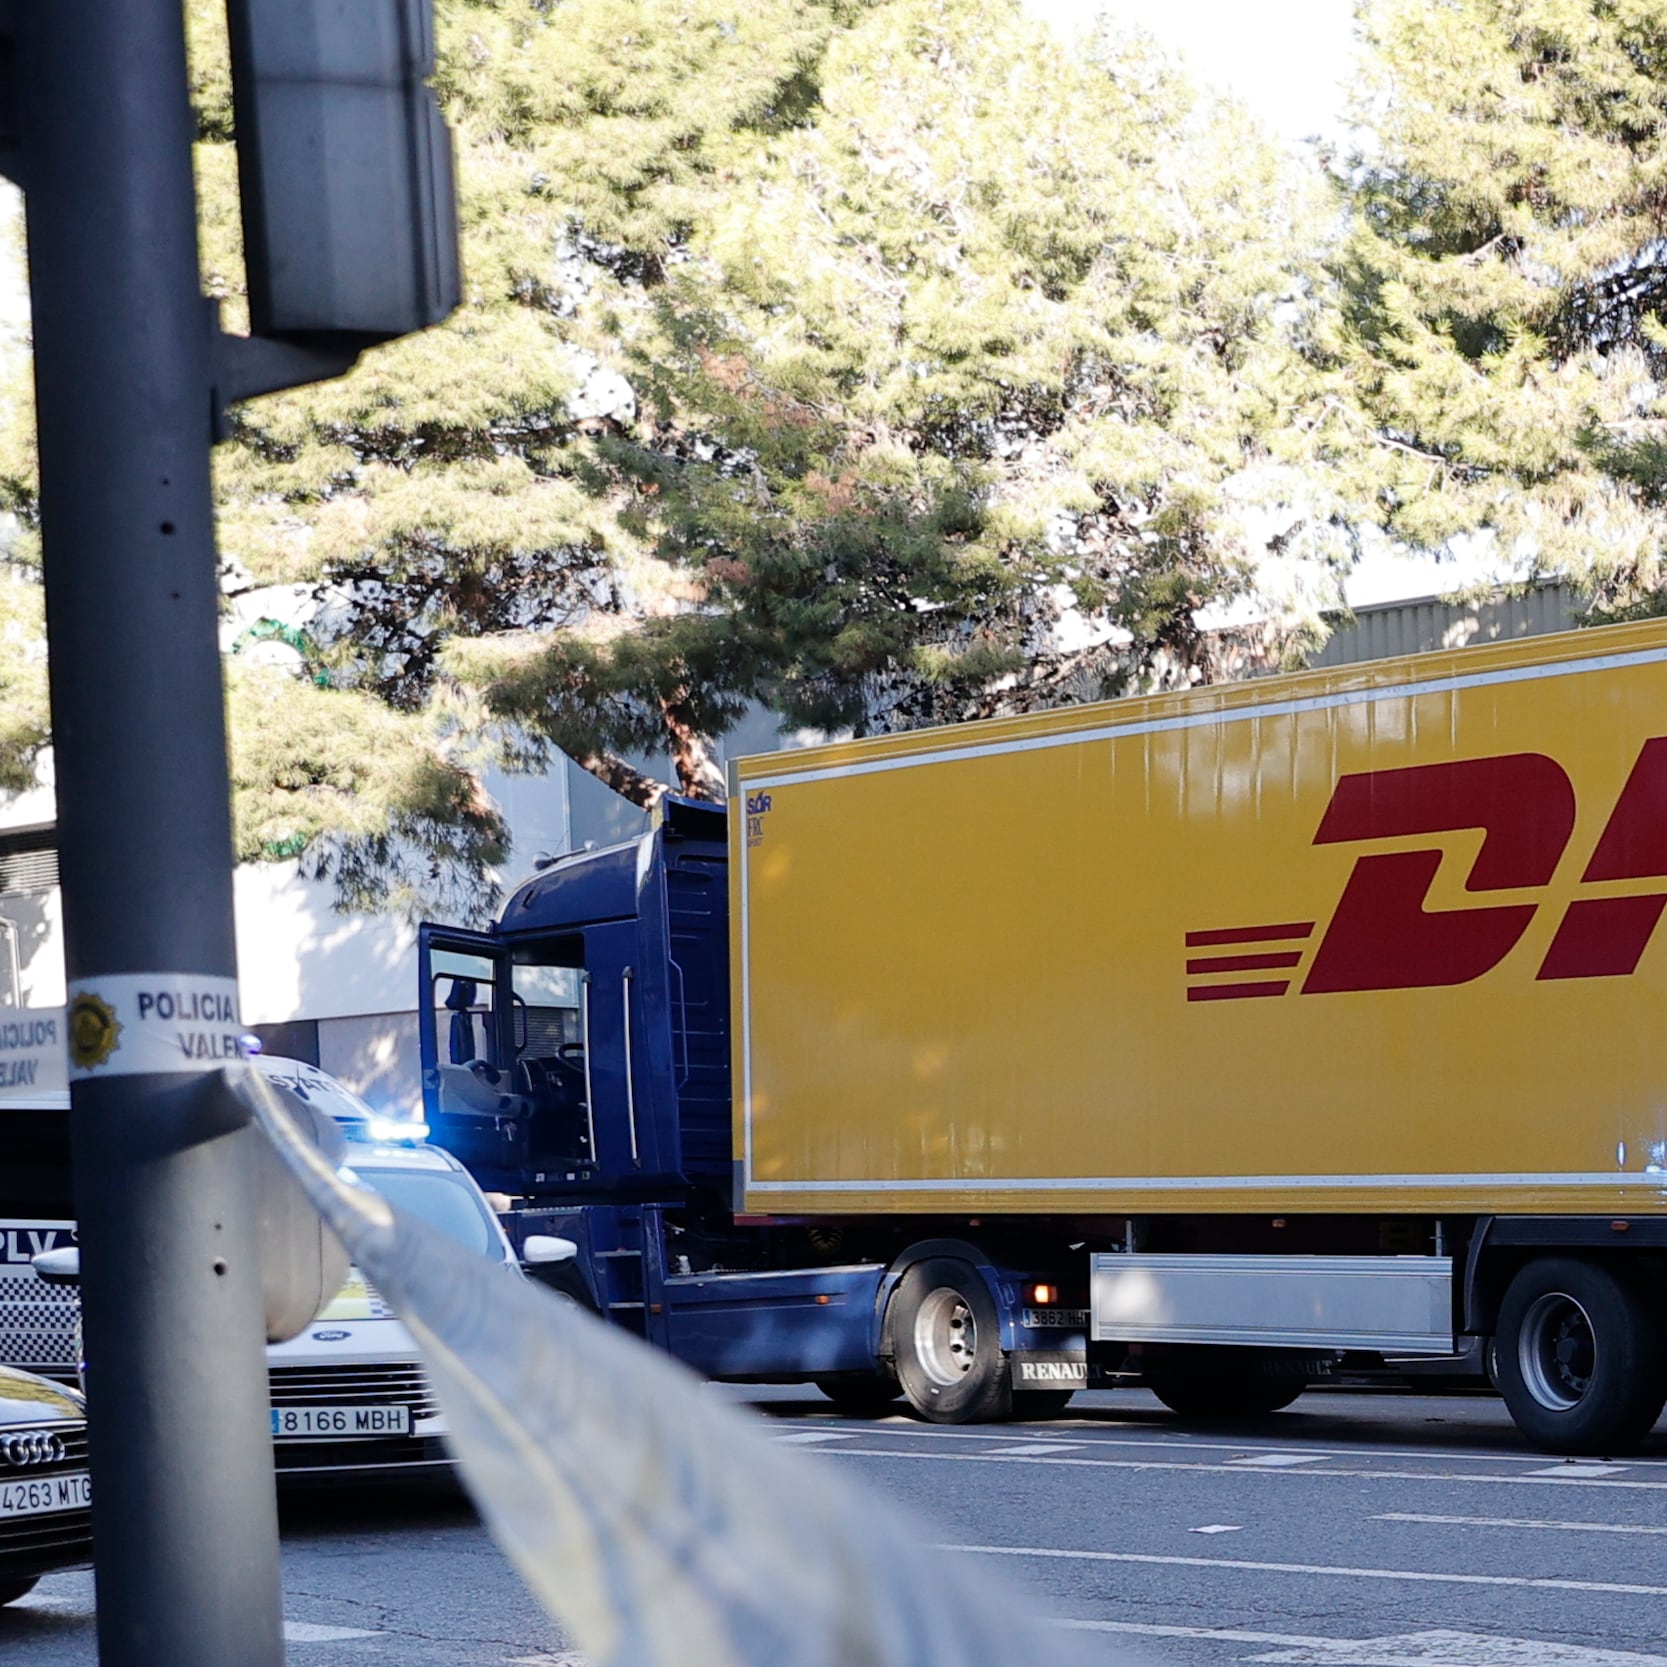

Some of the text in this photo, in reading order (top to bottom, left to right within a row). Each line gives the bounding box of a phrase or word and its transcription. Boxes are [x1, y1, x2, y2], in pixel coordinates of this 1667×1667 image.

[137, 990, 235, 1022] POLICIA
[0, 1230, 58, 1262] LV
[1032, 1311, 1064, 1325] 3862
[1020, 1362, 1103, 1380] RENAU
[284, 1410, 401, 1432] 8166 MBH
[2, 1477, 92, 1511] 4263 MTG
